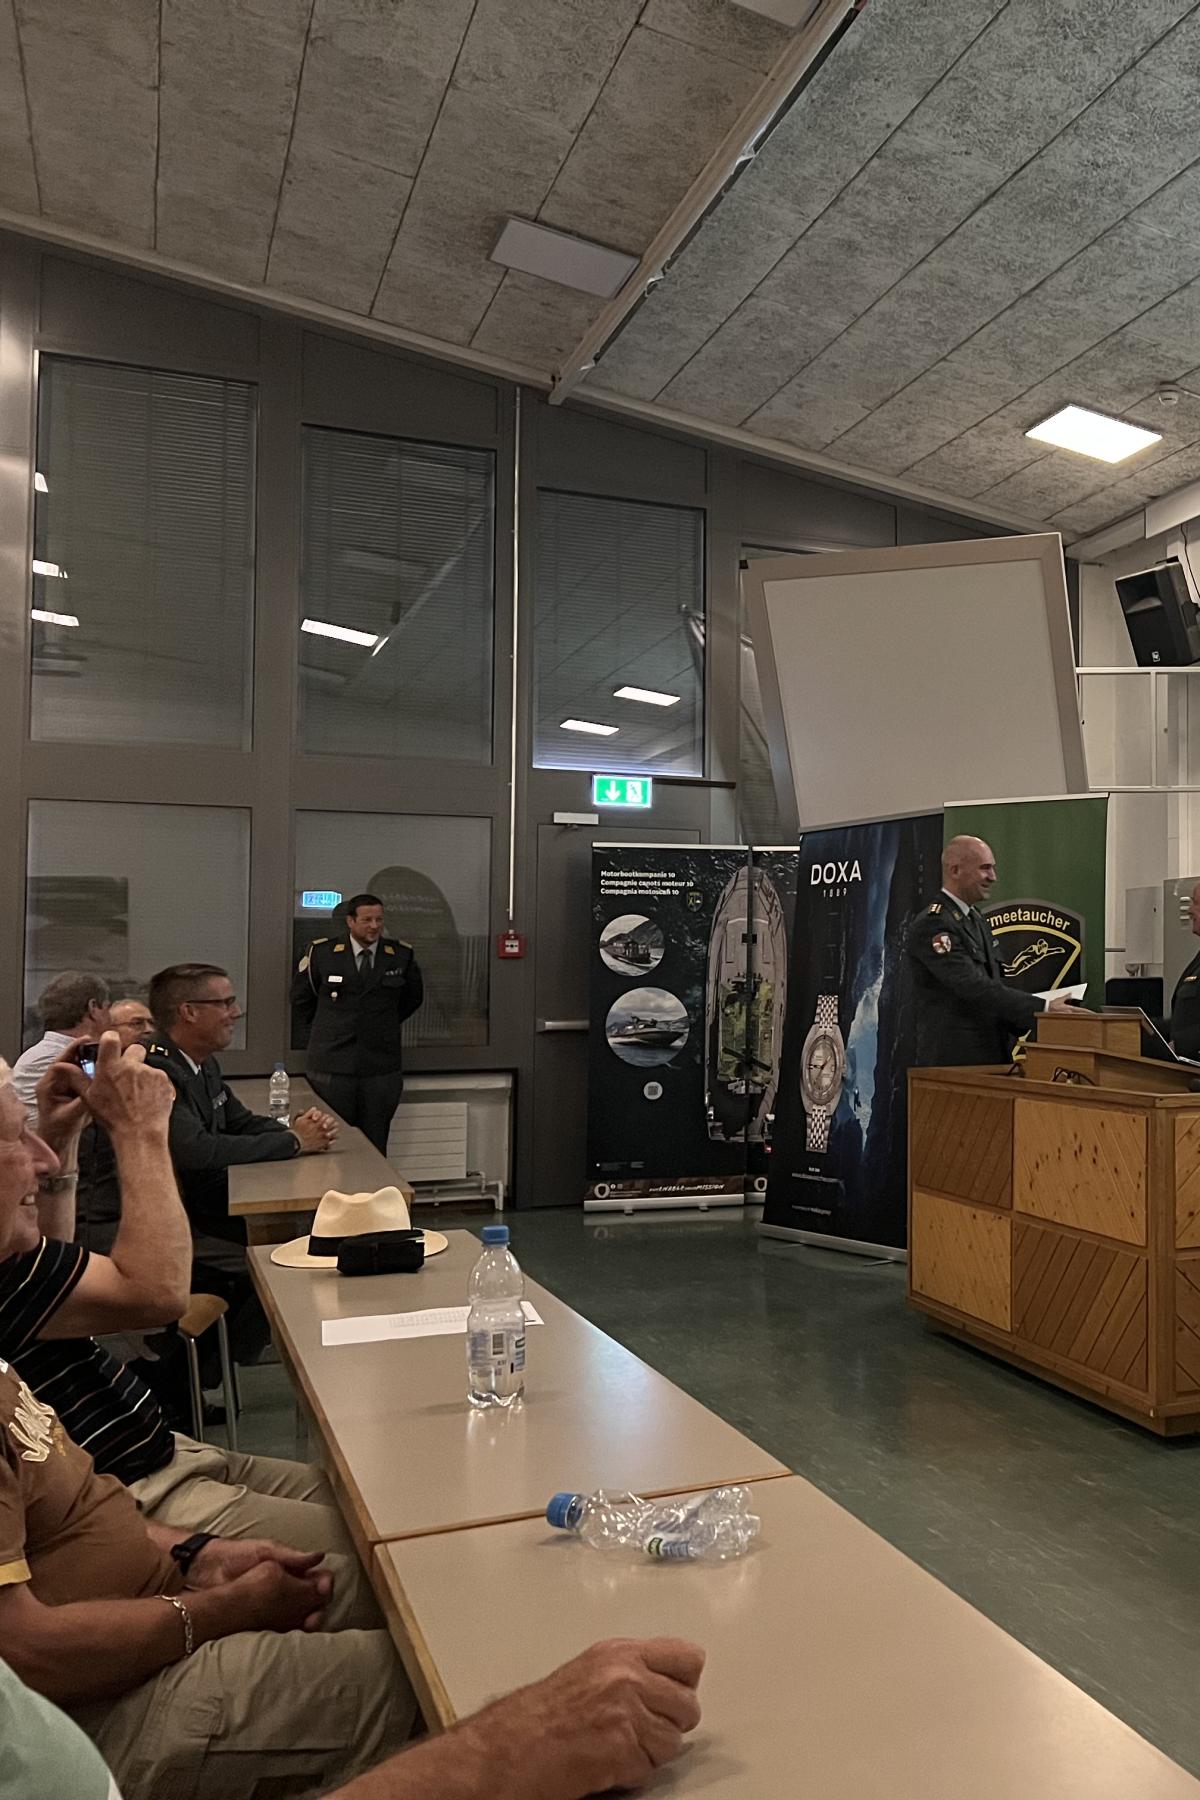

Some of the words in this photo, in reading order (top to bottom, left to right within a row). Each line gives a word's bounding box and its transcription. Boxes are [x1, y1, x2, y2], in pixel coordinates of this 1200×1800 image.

[810, 860, 862, 885] DOXA
[600, 879, 637, 888] Compagnie
[661, 880, 686, 888] moteur
[600, 888, 637, 896] Compagnia
[986, 907, 1071, 931] meetaucher
